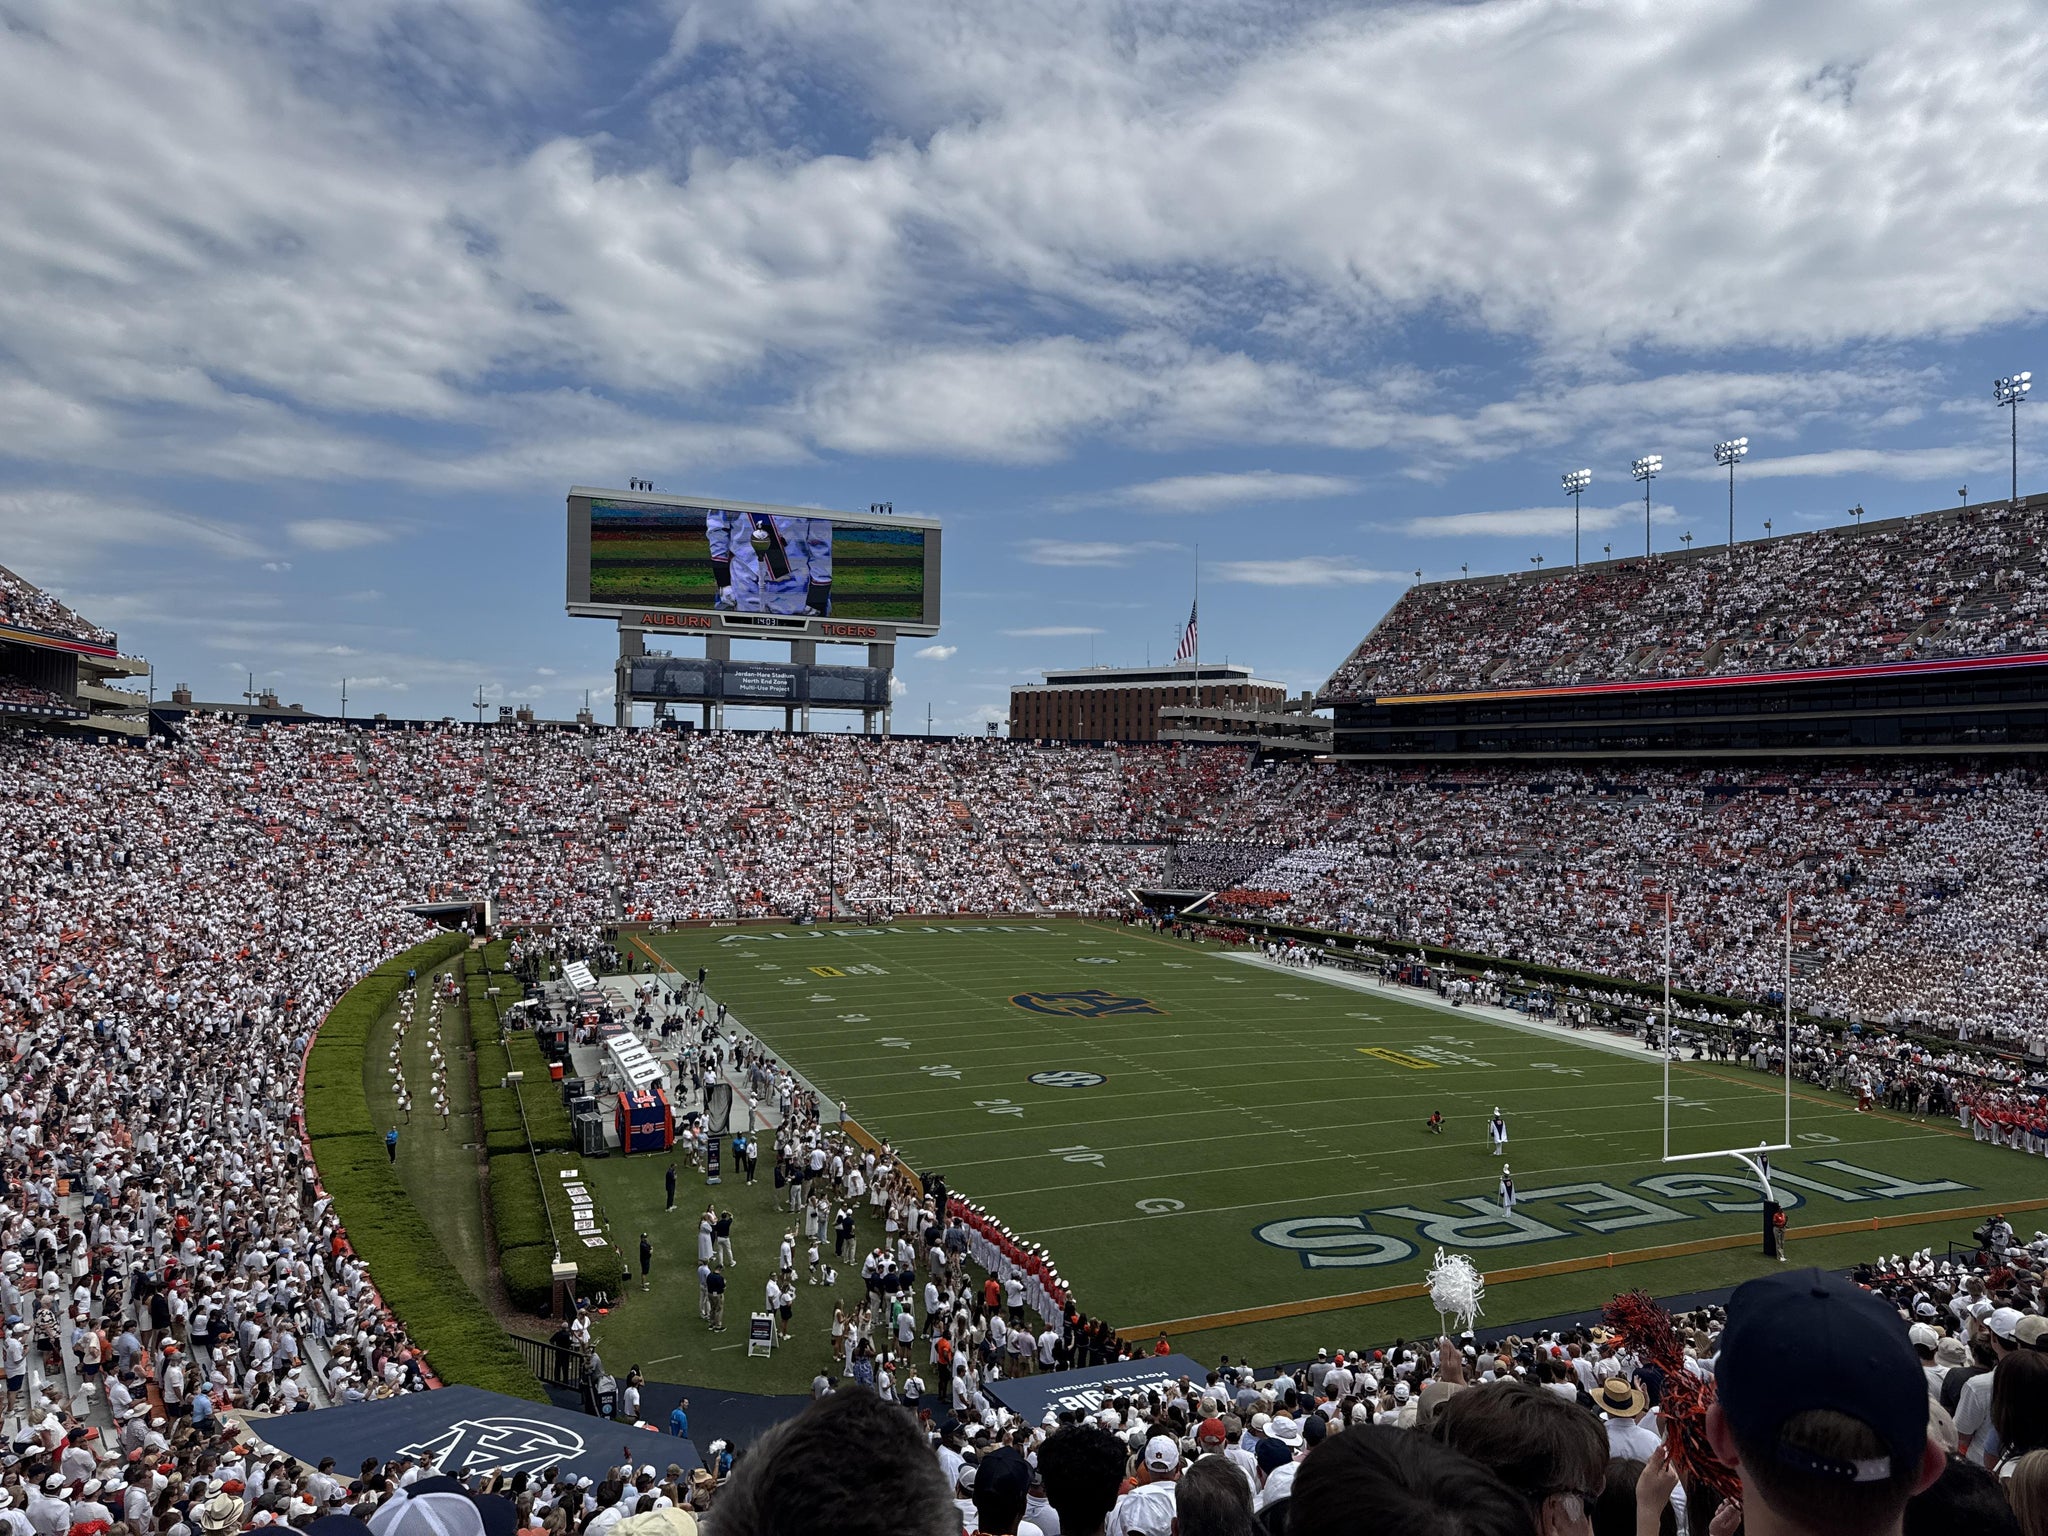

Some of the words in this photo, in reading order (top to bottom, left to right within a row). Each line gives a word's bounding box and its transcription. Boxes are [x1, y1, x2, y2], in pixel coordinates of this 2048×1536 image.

[642, 613, 712, 628] AUBURN
[822, 624, 877, 637] TIGERS
[713, 924, 1053, 943] AUBURN
[919, 1064, 963, 1078] 30
[973, 1098, 1025, 1115] 20
[1048, 1145, 1105, 1164] 10
[1135, 1197, 1186, 1214] G
[1253, 1157, 1978, 1271] TIGERS
[1103, 1376, 1137, 1385] Than
[1136, 1371, 1169, 1379] More
